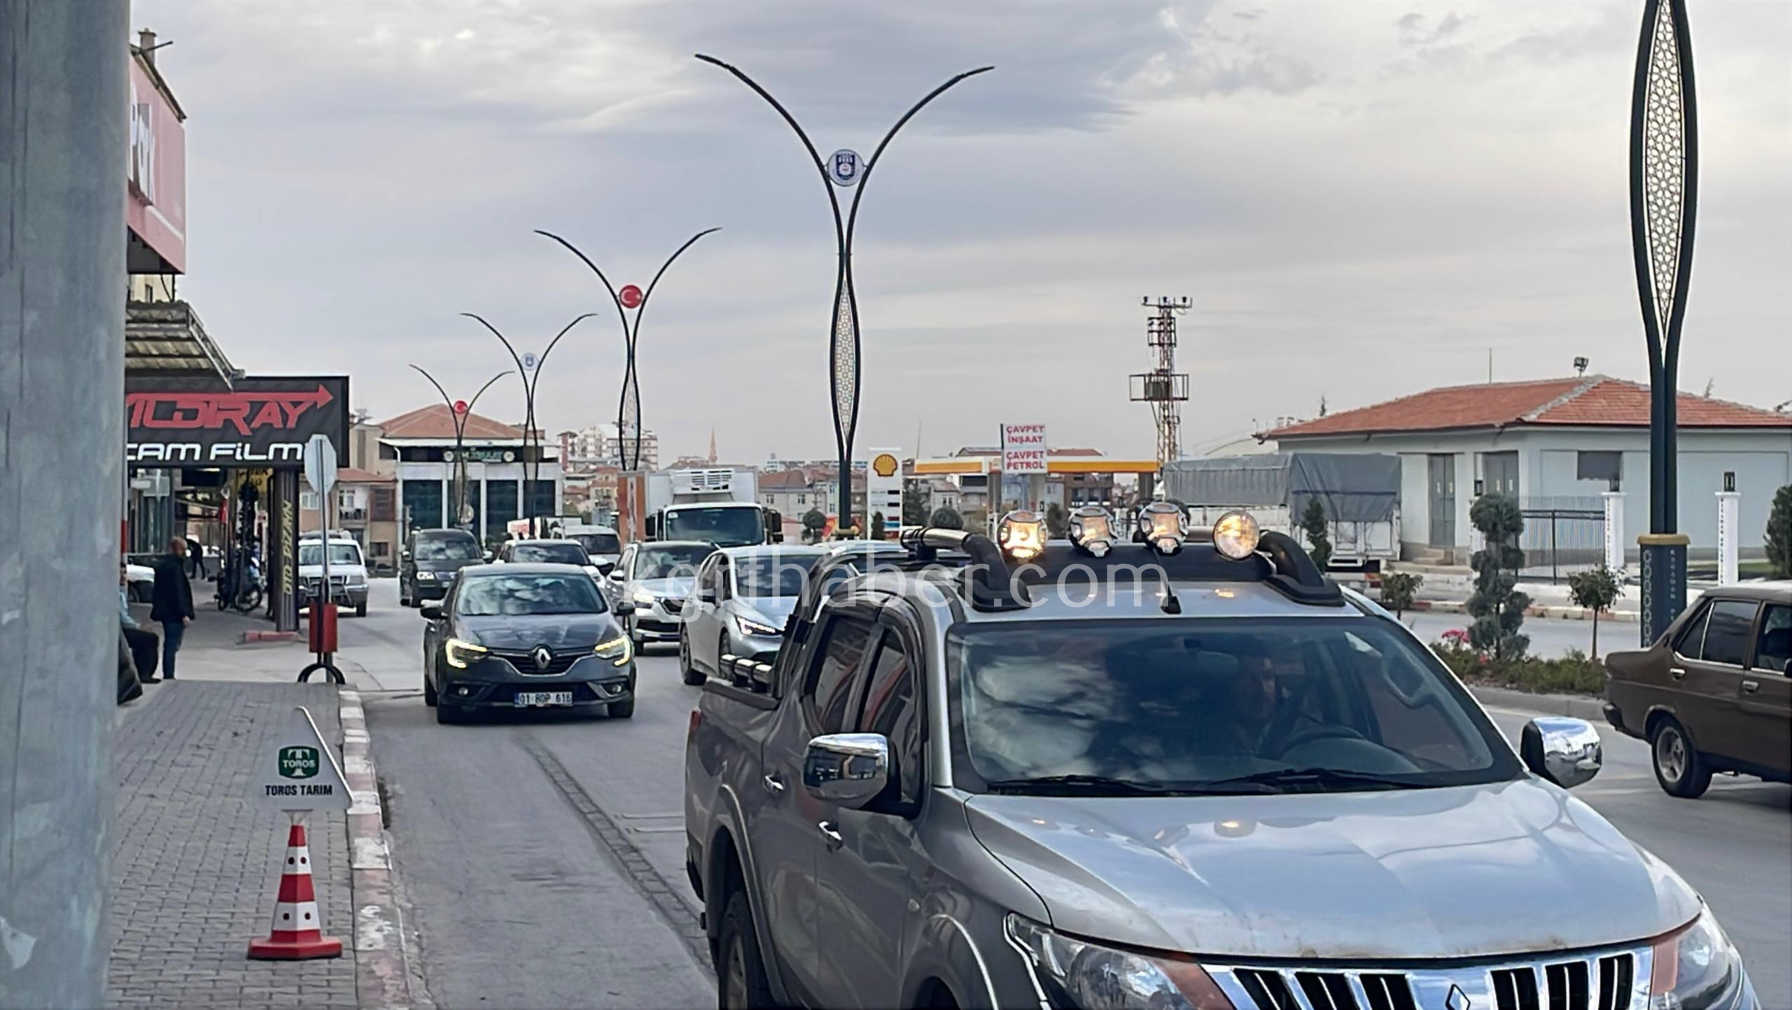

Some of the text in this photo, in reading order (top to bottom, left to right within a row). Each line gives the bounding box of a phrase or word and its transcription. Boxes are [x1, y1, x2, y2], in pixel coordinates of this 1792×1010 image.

[1006, 425, 1045, 434] ÇAVPET
[1007, 435, 1042, 444] İNŞAAT
[1007, 450, 1044, 460] ÇAVPET
[1006, 461, 1045, 470] PETROL
[265, 784, 333, 796] TOROS TARIM
